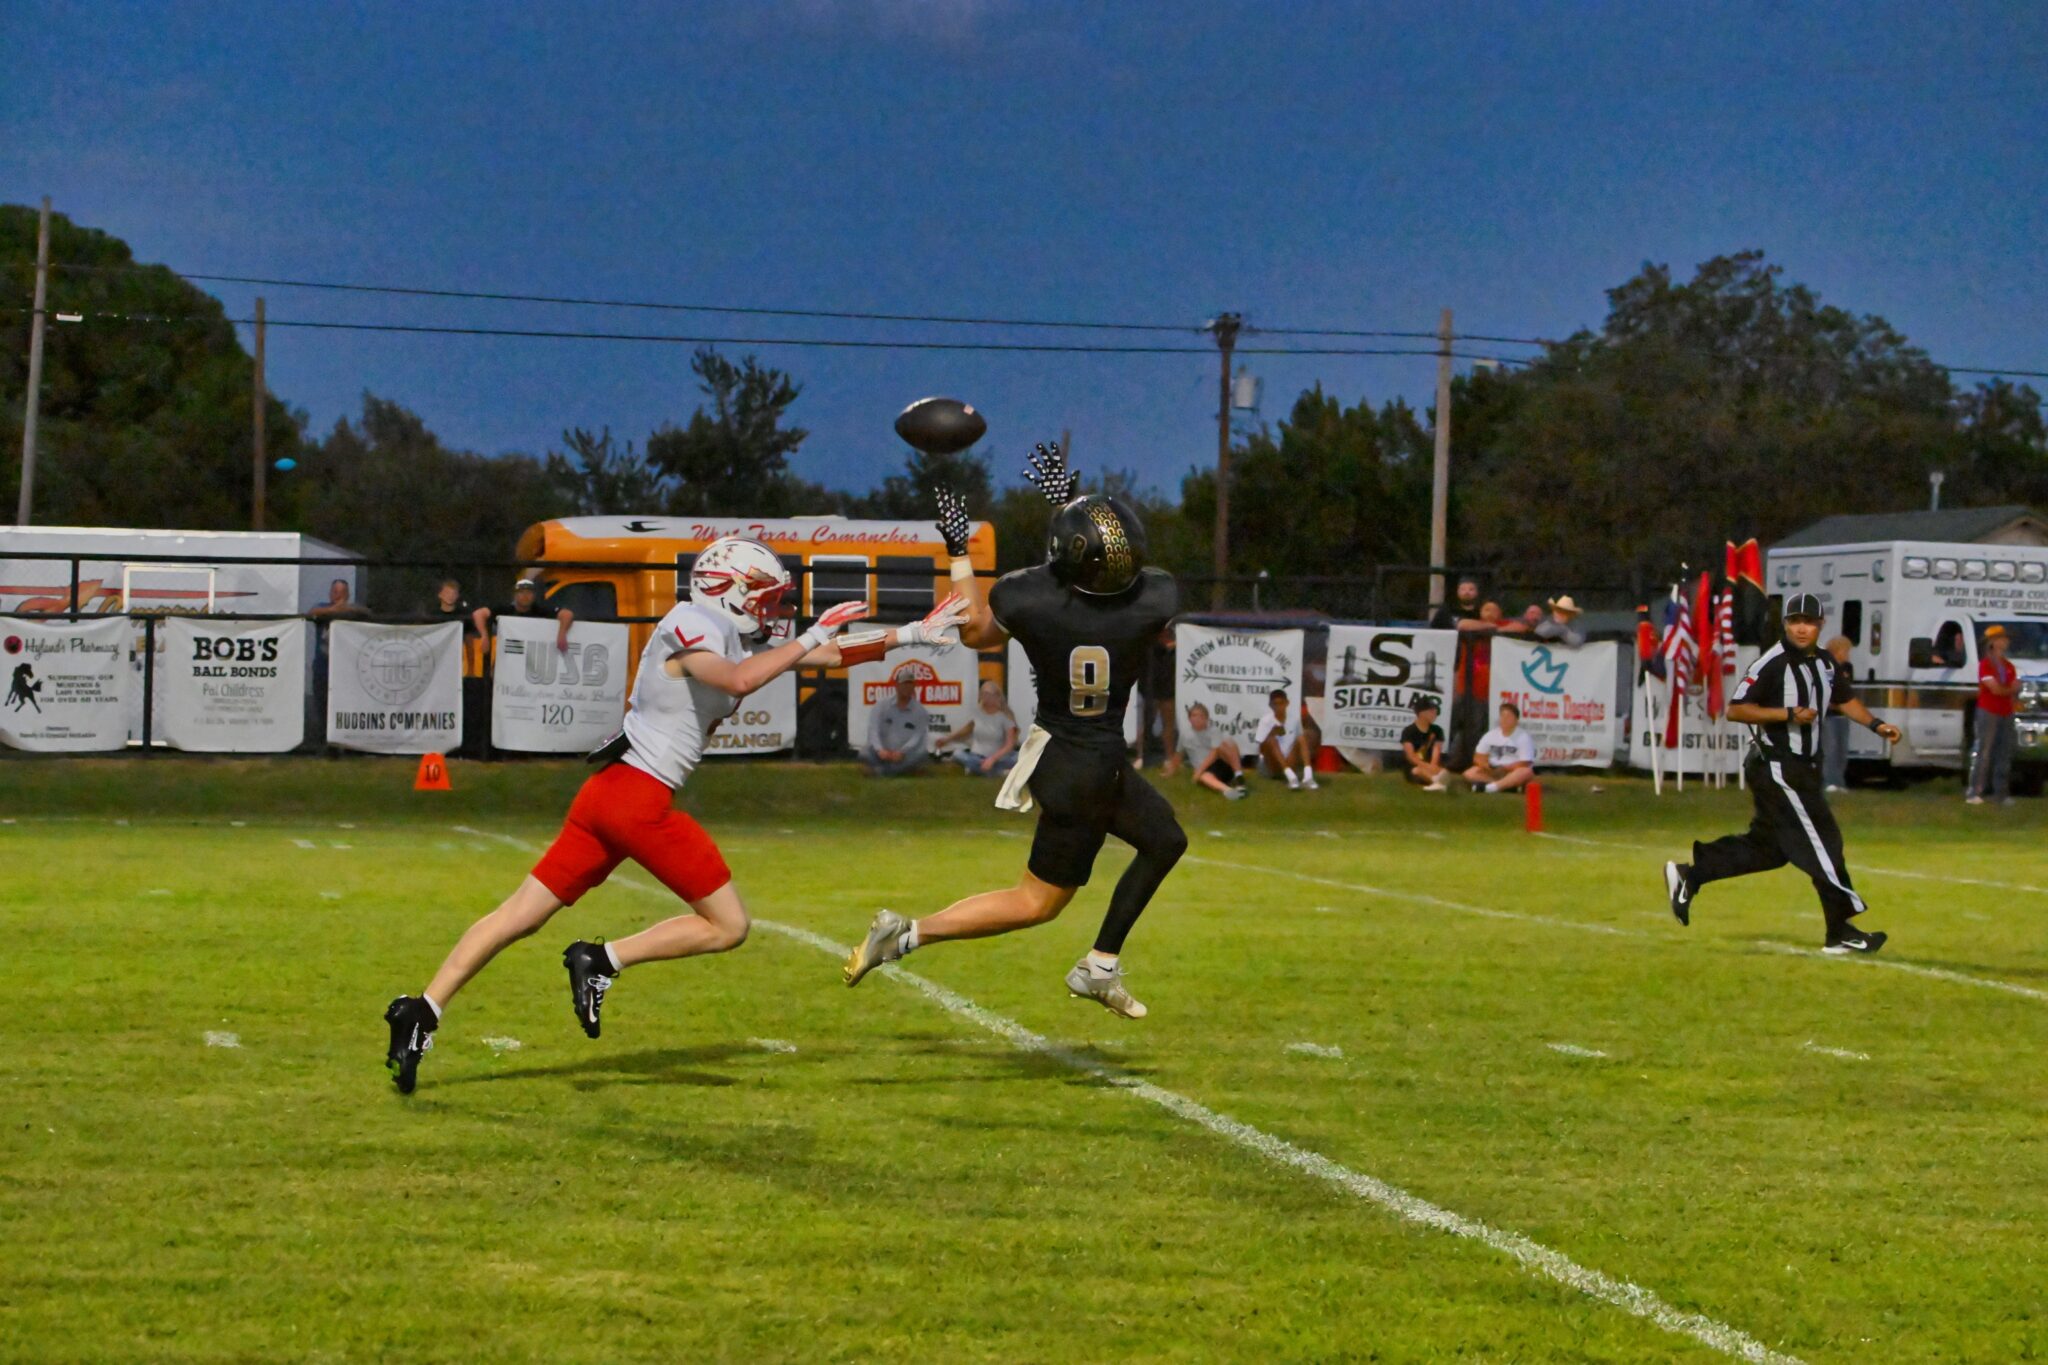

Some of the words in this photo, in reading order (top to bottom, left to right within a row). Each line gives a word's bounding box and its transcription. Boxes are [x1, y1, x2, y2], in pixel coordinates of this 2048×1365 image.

[748, 525, 799, 542] Texas
[811, 525, 920, 545] Comanches
[1934, 586, 1970, 597] NORTH
[1973, 588, 2023, 599] WHEELER
[1945, 599, 2009, 609] AMBULANCE
[193, 636, 279, 661] BOB'S
[1187, 640, 1216, 669] ARROW
[1216, 634, 1249, 648] WATER
[1252, 638, 1276, 659] WELL
[193, 666, 227, 677] BAIL
[230, 666, 277, 678] BONDS
[925, 685, 960, 702] BARN
[336, 712, 386, 730] HUDGINS
[541, 704, 574, 726] 120
[743, 710, 771, 726] GO
[710, 732, 782, 749] STANGS!
[426, 764, 441, 782] 10
